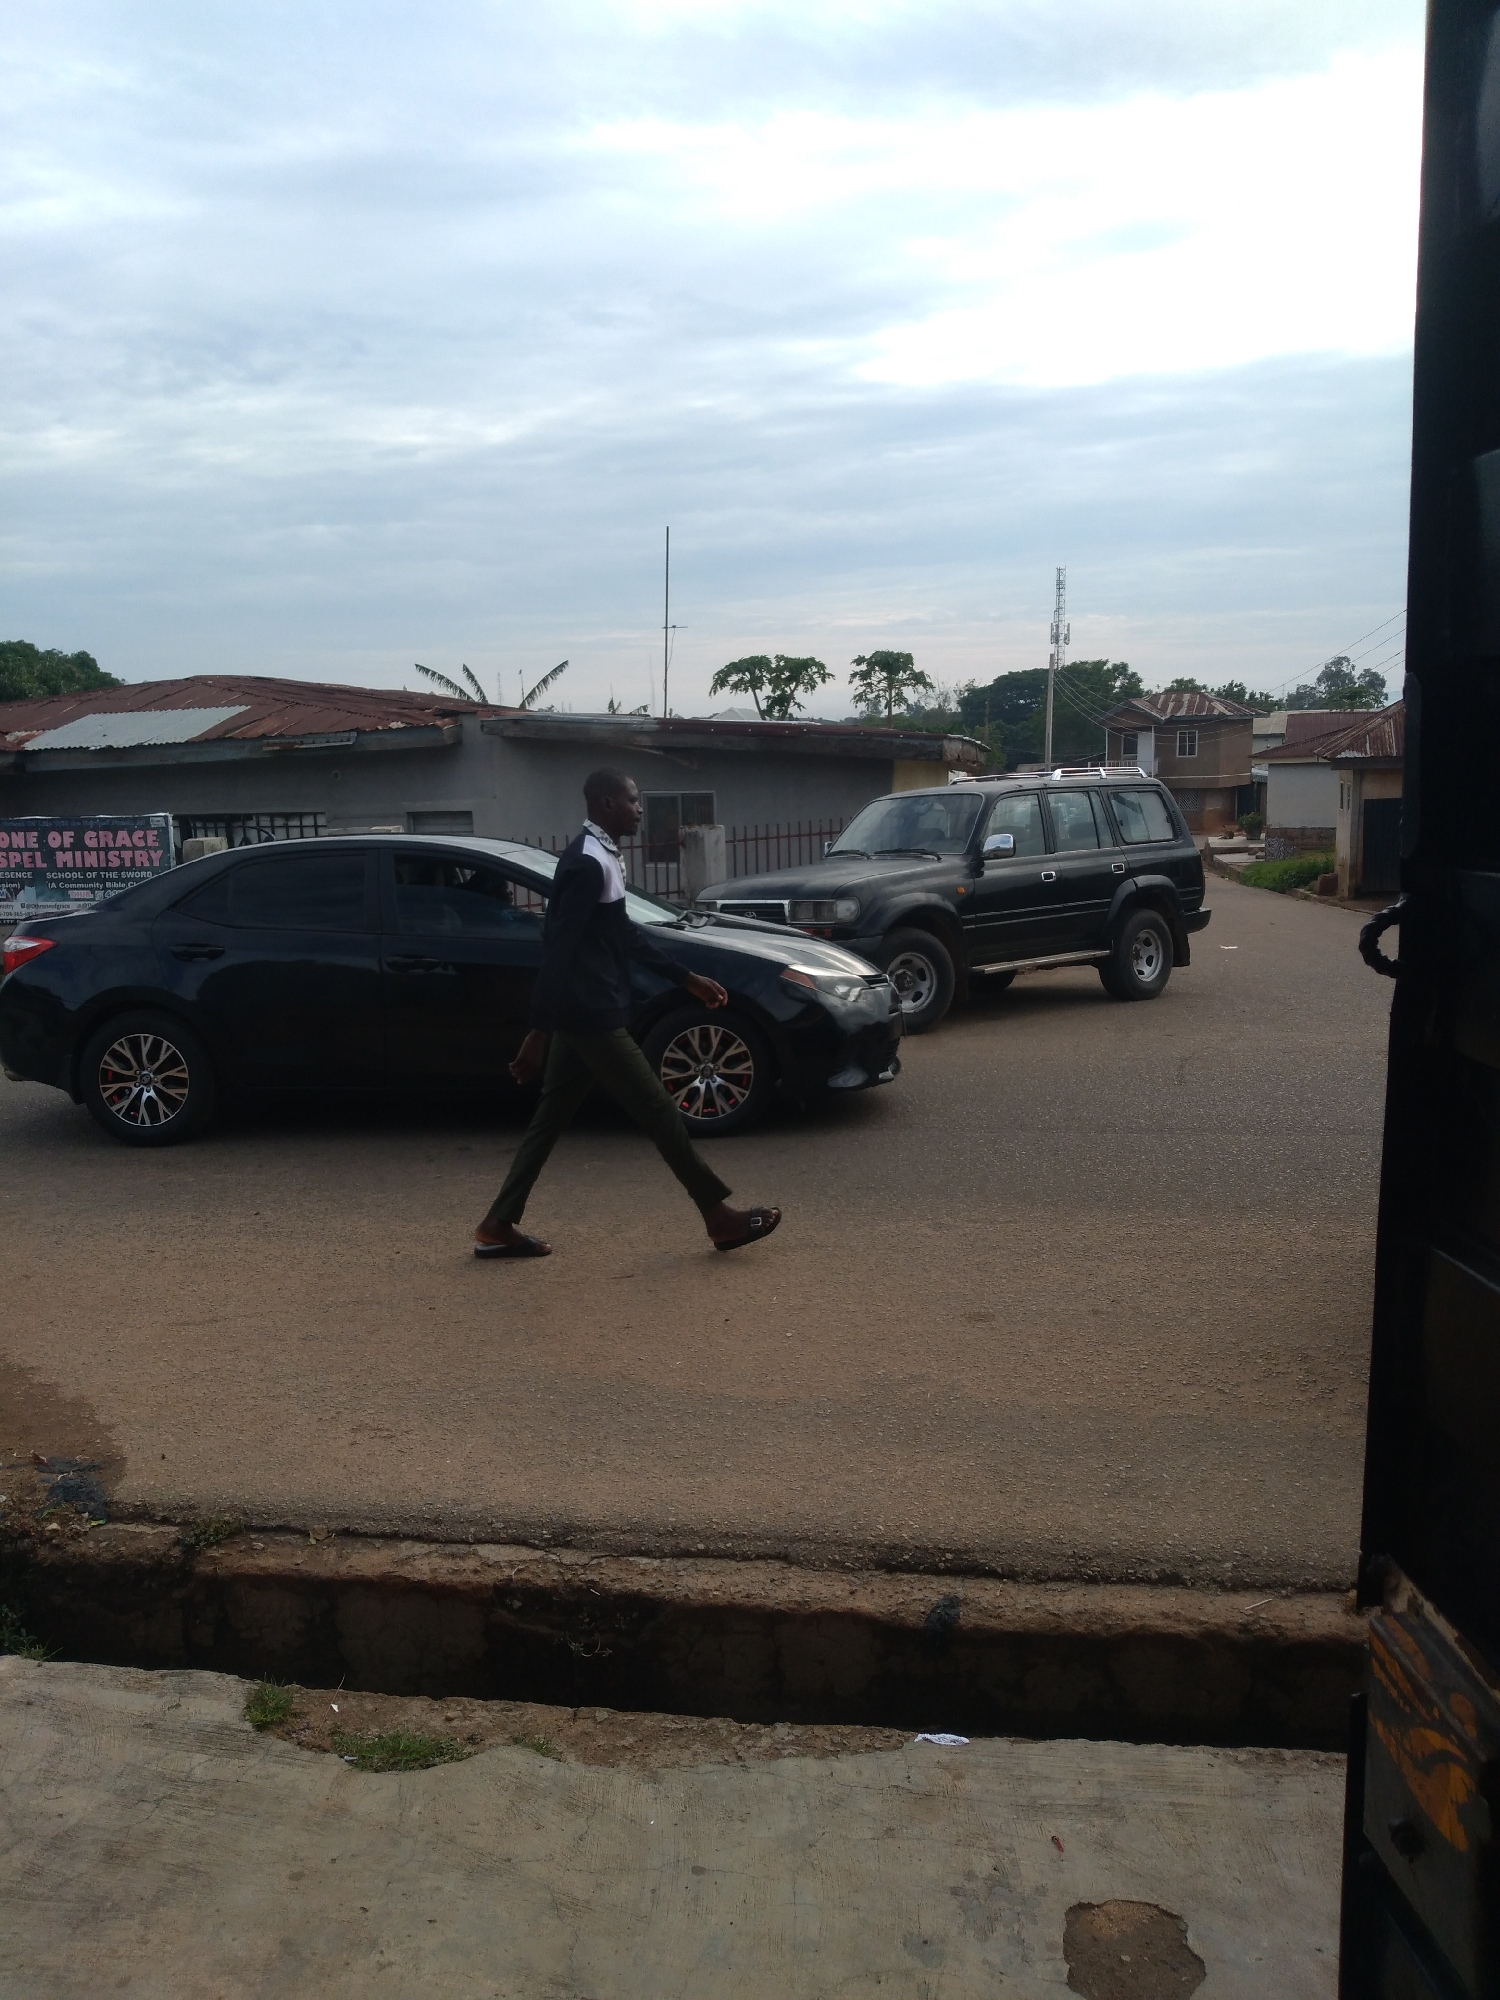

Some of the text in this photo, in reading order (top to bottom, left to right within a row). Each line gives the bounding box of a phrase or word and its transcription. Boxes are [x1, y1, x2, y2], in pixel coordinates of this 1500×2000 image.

[47, 830, 75, 848] OF
[84, 829, 159, 848] GRACE
[0, 849, 164, 868] SPEL MINISTRY
[46, 870, 153, 879] SCHOOL OF THE SWORD
[48, 881, 57, 890] (A
[59, 880, 104, 890] Community
[105, 880, 126, 888] Bible
[68, 890, 94, 899] THUR.
